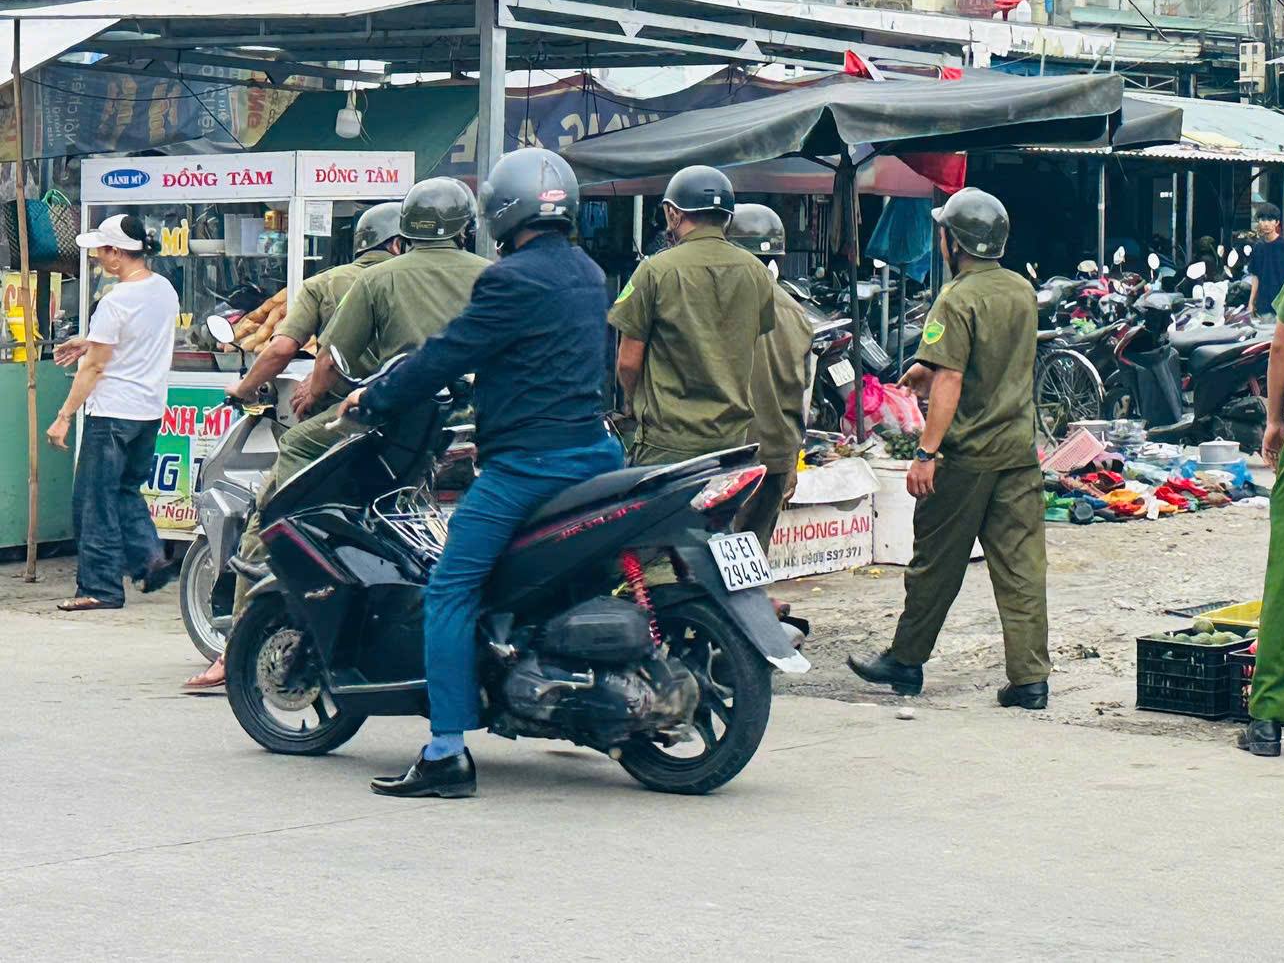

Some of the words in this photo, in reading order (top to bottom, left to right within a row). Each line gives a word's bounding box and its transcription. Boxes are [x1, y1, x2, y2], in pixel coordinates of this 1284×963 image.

[162, 167, 218, 187] ĐỒNG
[227, 168, 273, 186] TÂM
[315, 162, 359, 183] ĐỒNG
[365, 166, 399, 183] TÂM
[160, 405, 198, 436] NH
[718, 536, 756, 561] 43-E1
[723, 558, 770, 587] 294.94
